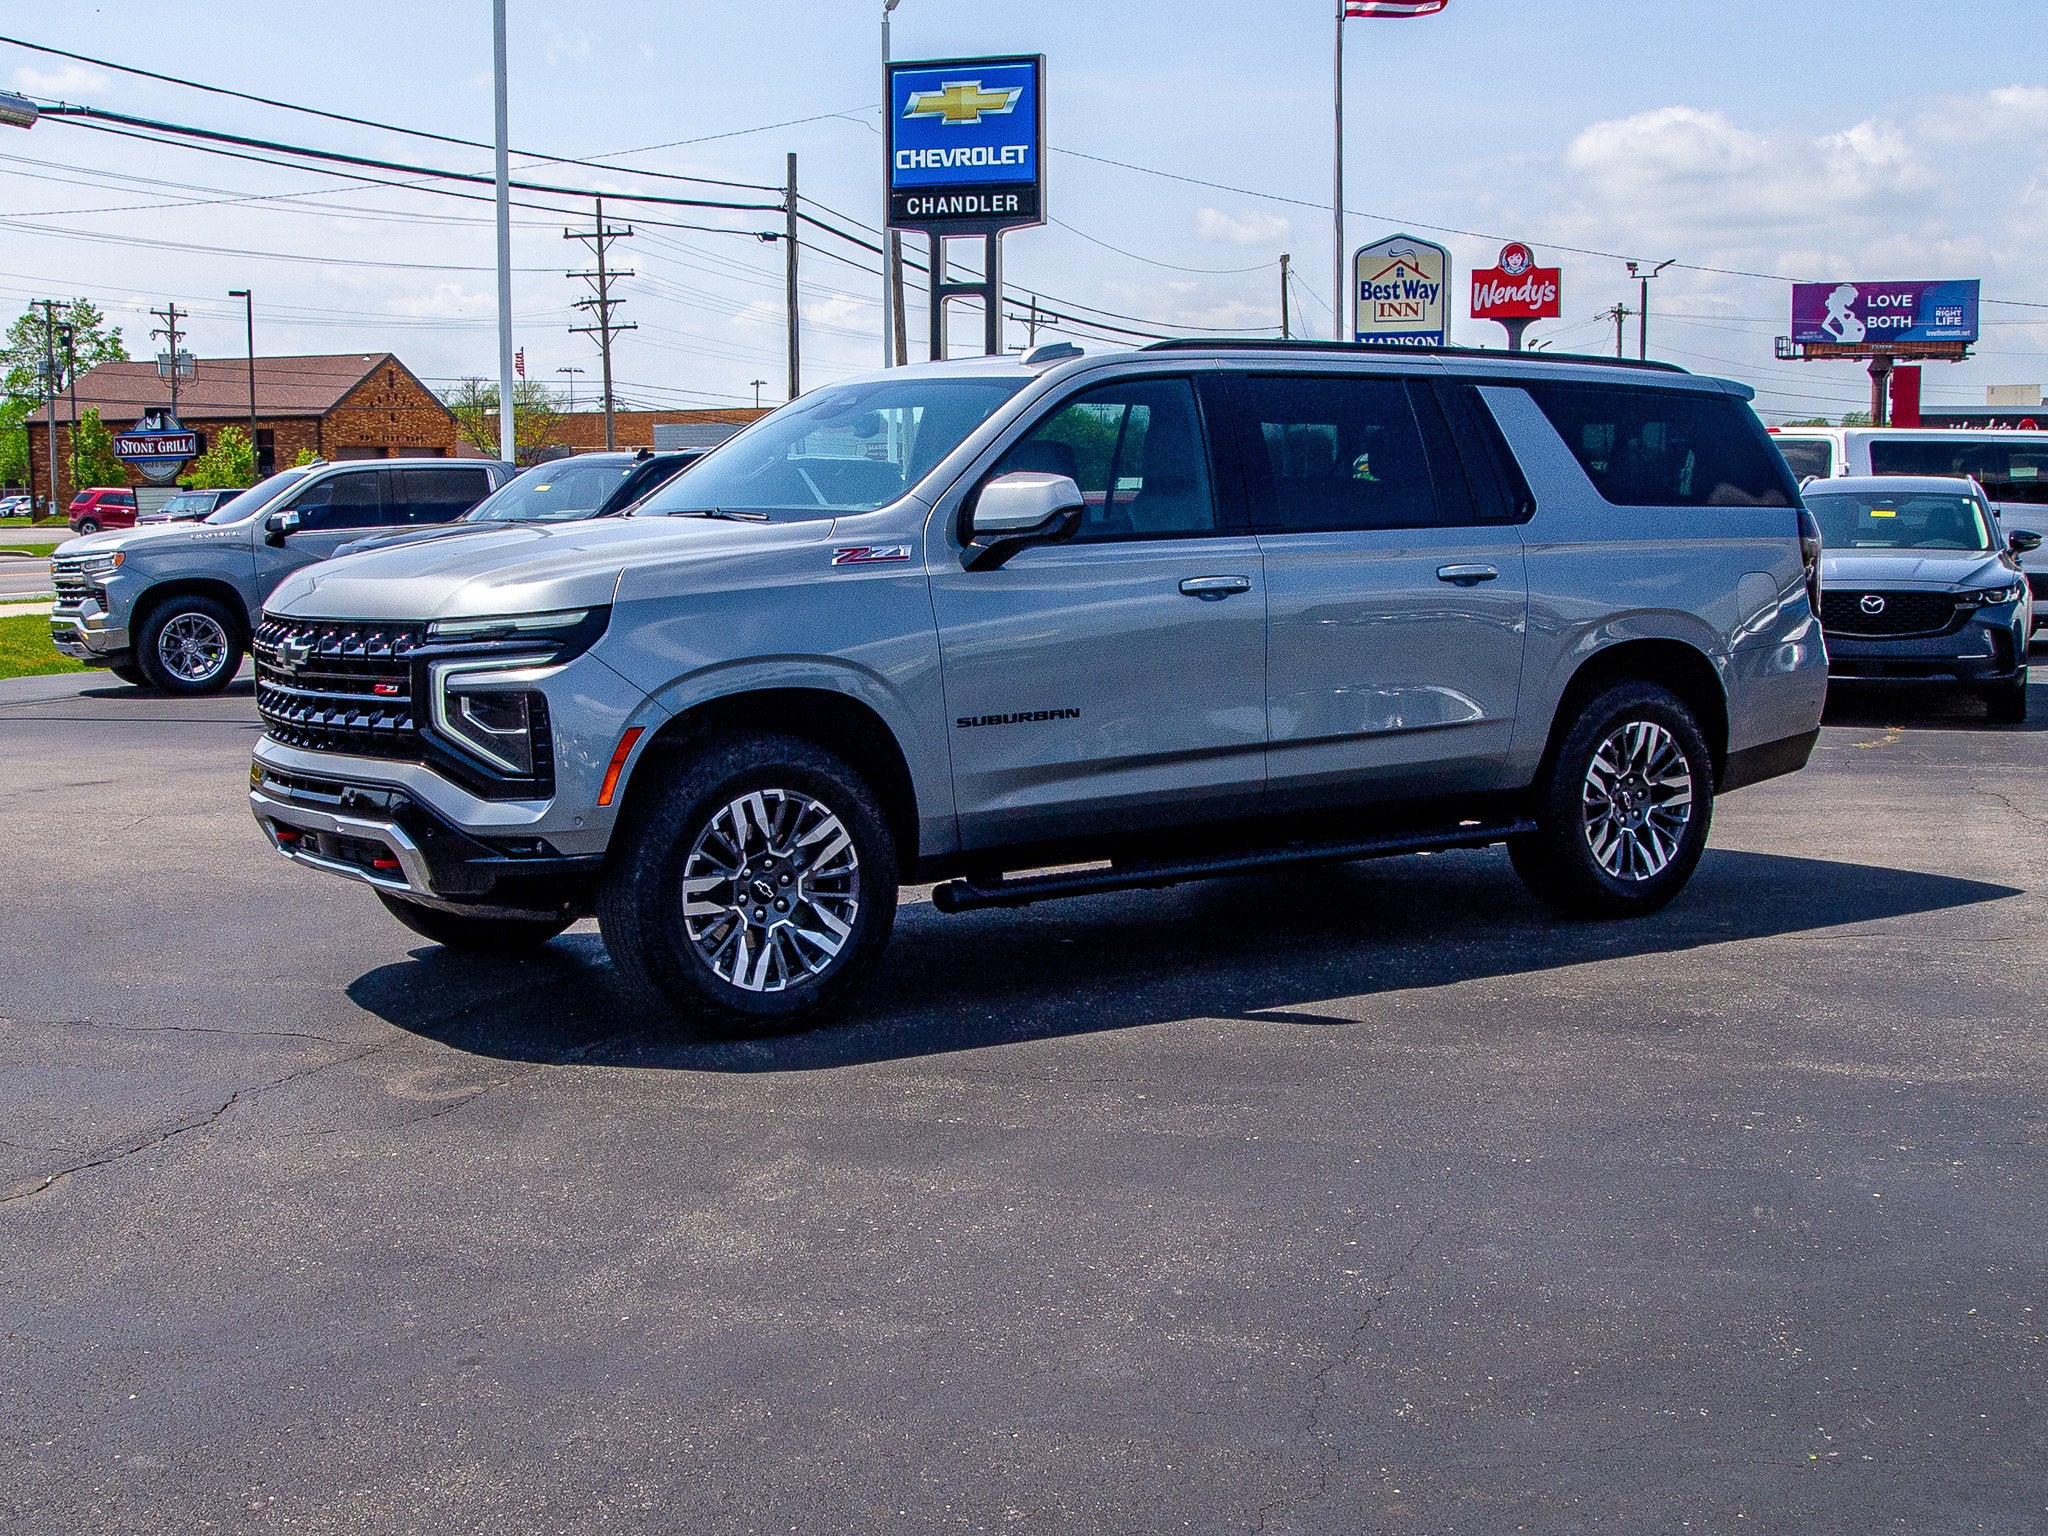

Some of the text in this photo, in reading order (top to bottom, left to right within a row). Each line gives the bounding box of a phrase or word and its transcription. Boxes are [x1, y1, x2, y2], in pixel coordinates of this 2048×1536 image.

[896, 145, 1028, 169] CHEVROLET
[907, 195, 1018, 214] CHANDLER
[1360, 279, 1440, 305] Best Way
[1474, 275, 1555, 311] Wendy's
[1867, 295, 1912, 307] LOVE
[1378, 302, 1421, 317] INN
[1867, 316, 1912, 328] BOTH
[1935, 316, 1962, 326] LIFE
[121, 439, 189, 454] STONE GRILL
[831, 544, 912, 566] Z71
[957, 708, 1080, 728] SUBURBAN
